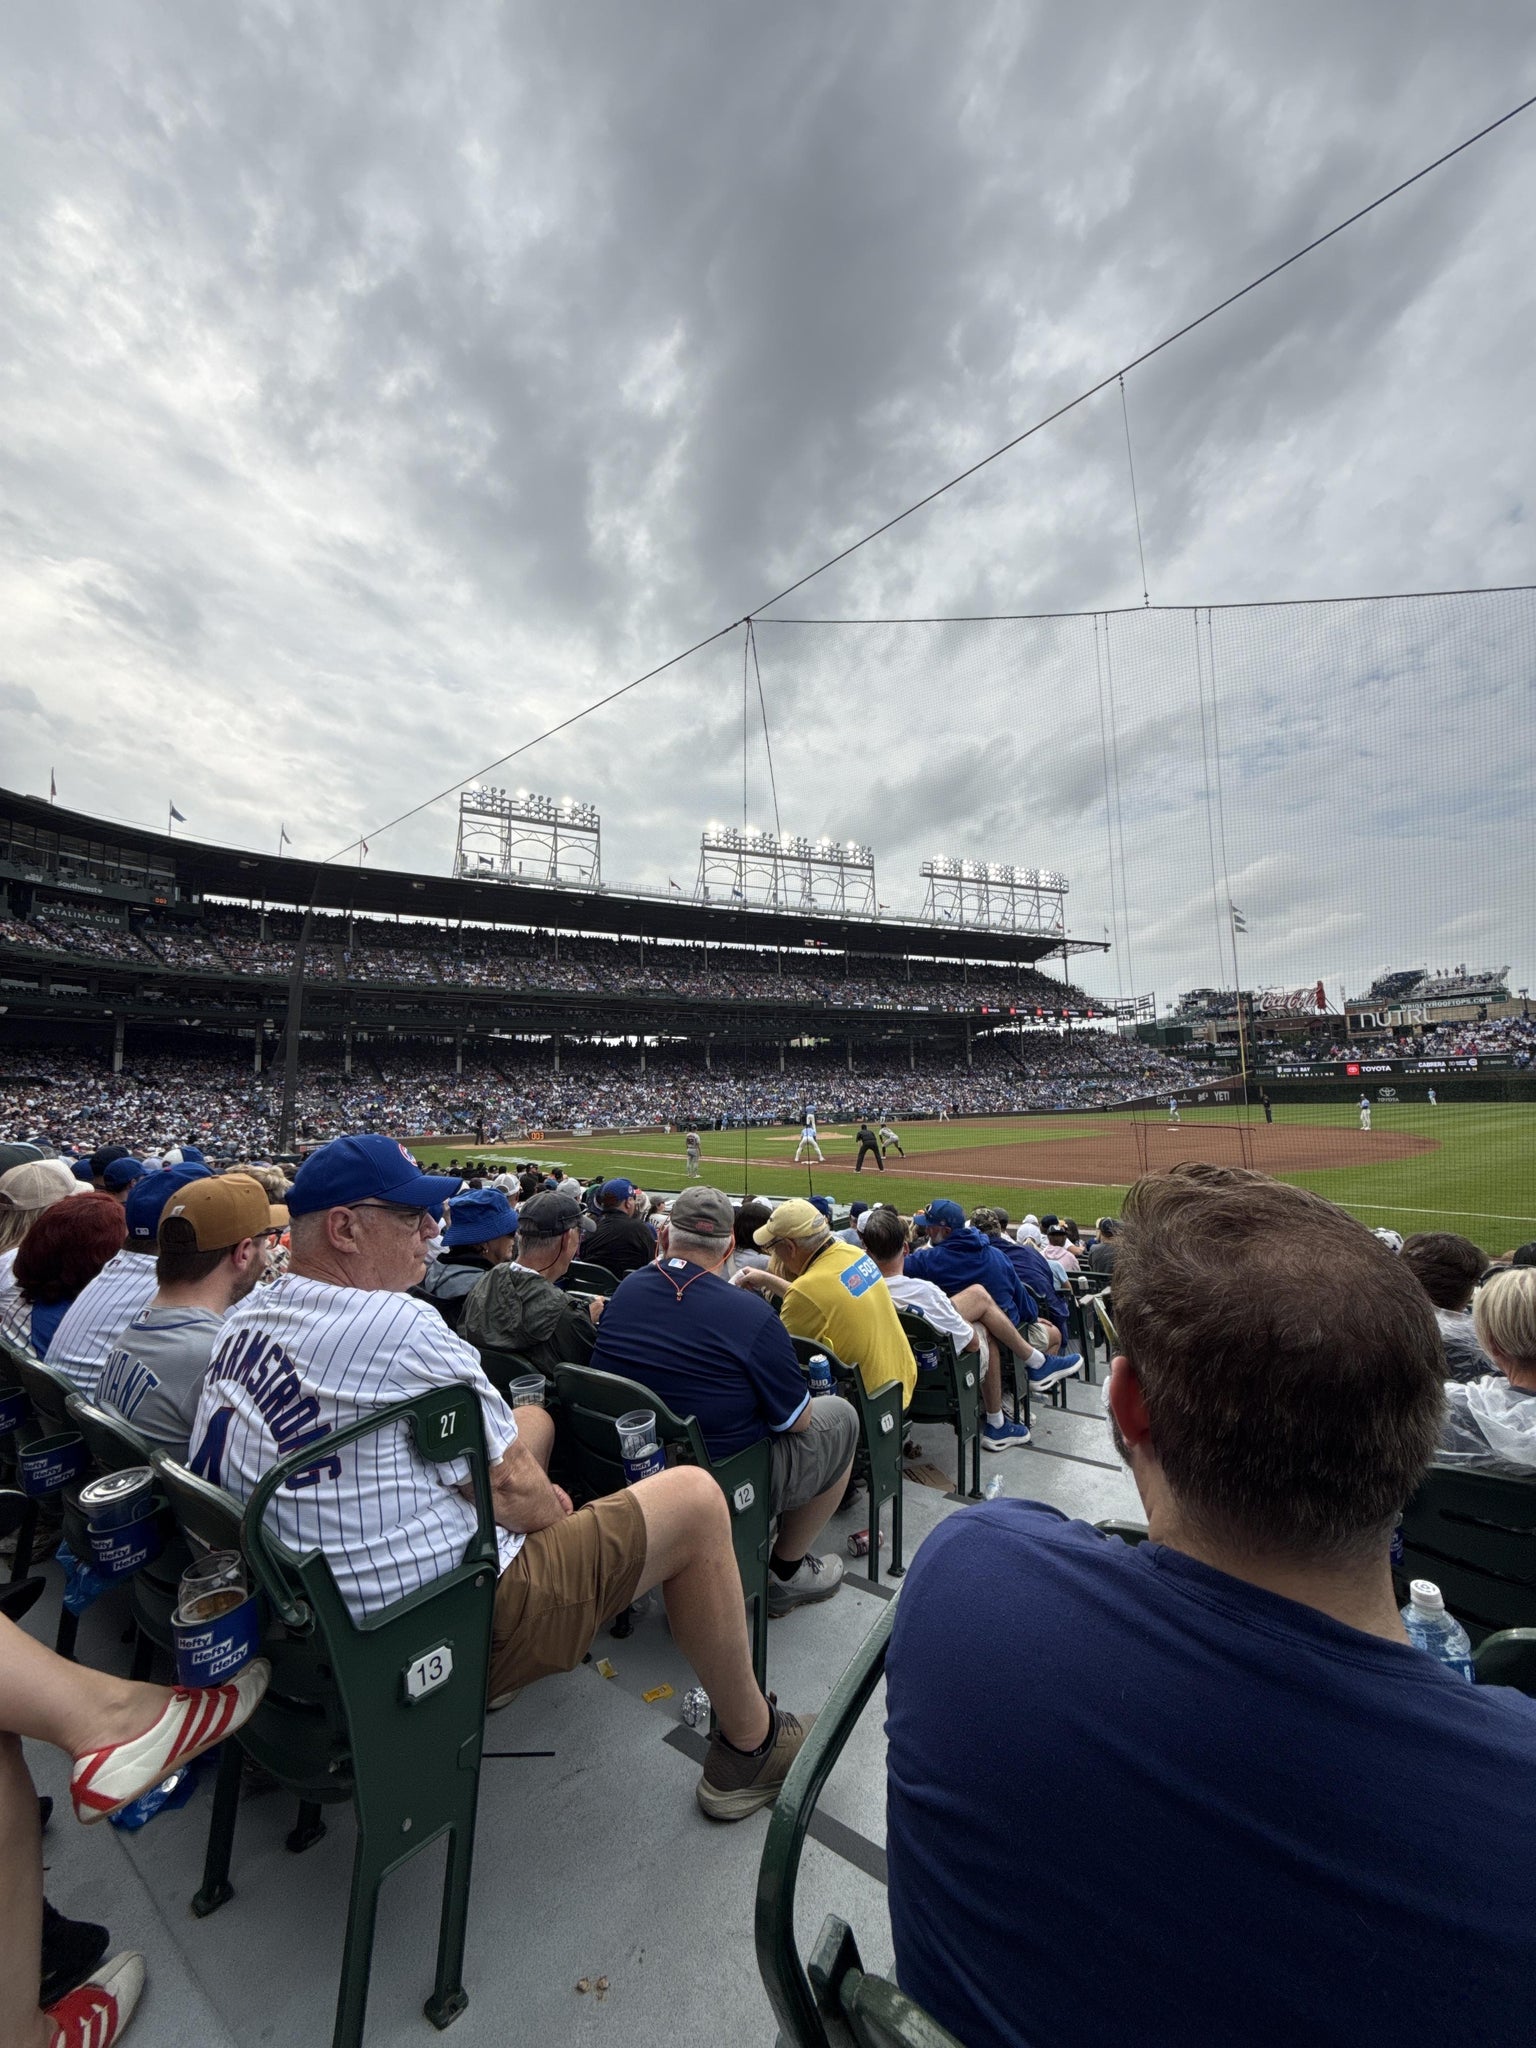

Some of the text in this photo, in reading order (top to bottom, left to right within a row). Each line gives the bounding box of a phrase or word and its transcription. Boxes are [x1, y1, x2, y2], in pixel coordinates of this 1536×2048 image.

[57, 879, 100, 894] Southwest
[41, 906, 120, 925] CATALINA CLUB
[1400, 996, 1492, 1010] WRIGLEYROOFTOPS.COM
[1360, 1064, 1392, 1072] TOYOTA
[1213, 1090, 1230, 1102] YETI
[531, 1131, 545, 1140] 003
[811, 1378, 829, 1387] BUD
[440, 1411, 456, 1438] 27
[884, 1417, 892, 1426] 11
[34, 1466, 61, 1479] Hefty
[46, 1470, 75, 1486] Hefty
[738, 1487, 751, 1505] 12
[100, 1547, 130, 1560] Hefty
[114, 1551, 146, 1570] Hefty
[179, 1635, 211, 1648] Hefty
[194, 1643, 230, 1663] Hefty
[212, 1647, 247, 1673] Hefty
[417, 1655, 443, 1687] 13
